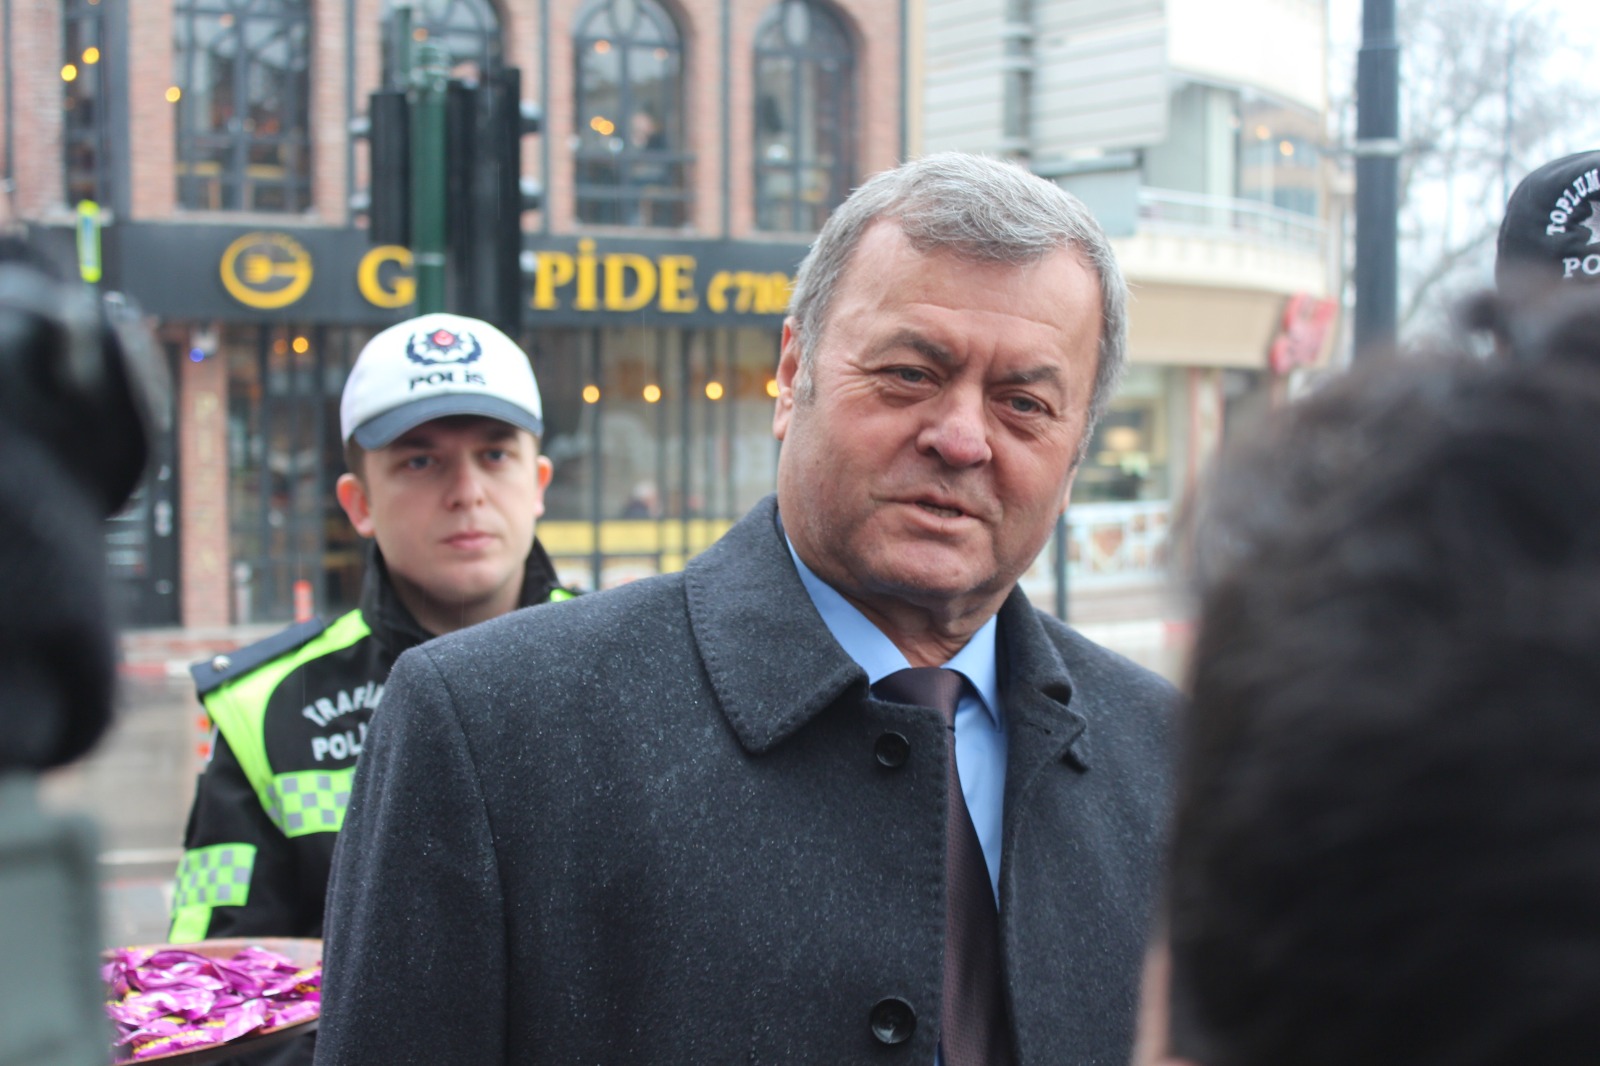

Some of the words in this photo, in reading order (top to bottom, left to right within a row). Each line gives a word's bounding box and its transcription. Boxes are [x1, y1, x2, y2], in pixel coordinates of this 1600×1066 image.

[1546, 168, 1600, 236] TOPLUM
[531, 237, 698, 313] PİDE
[1562, 253, 1600, 279] PO
[311, 722, 369, 761] POLİ
